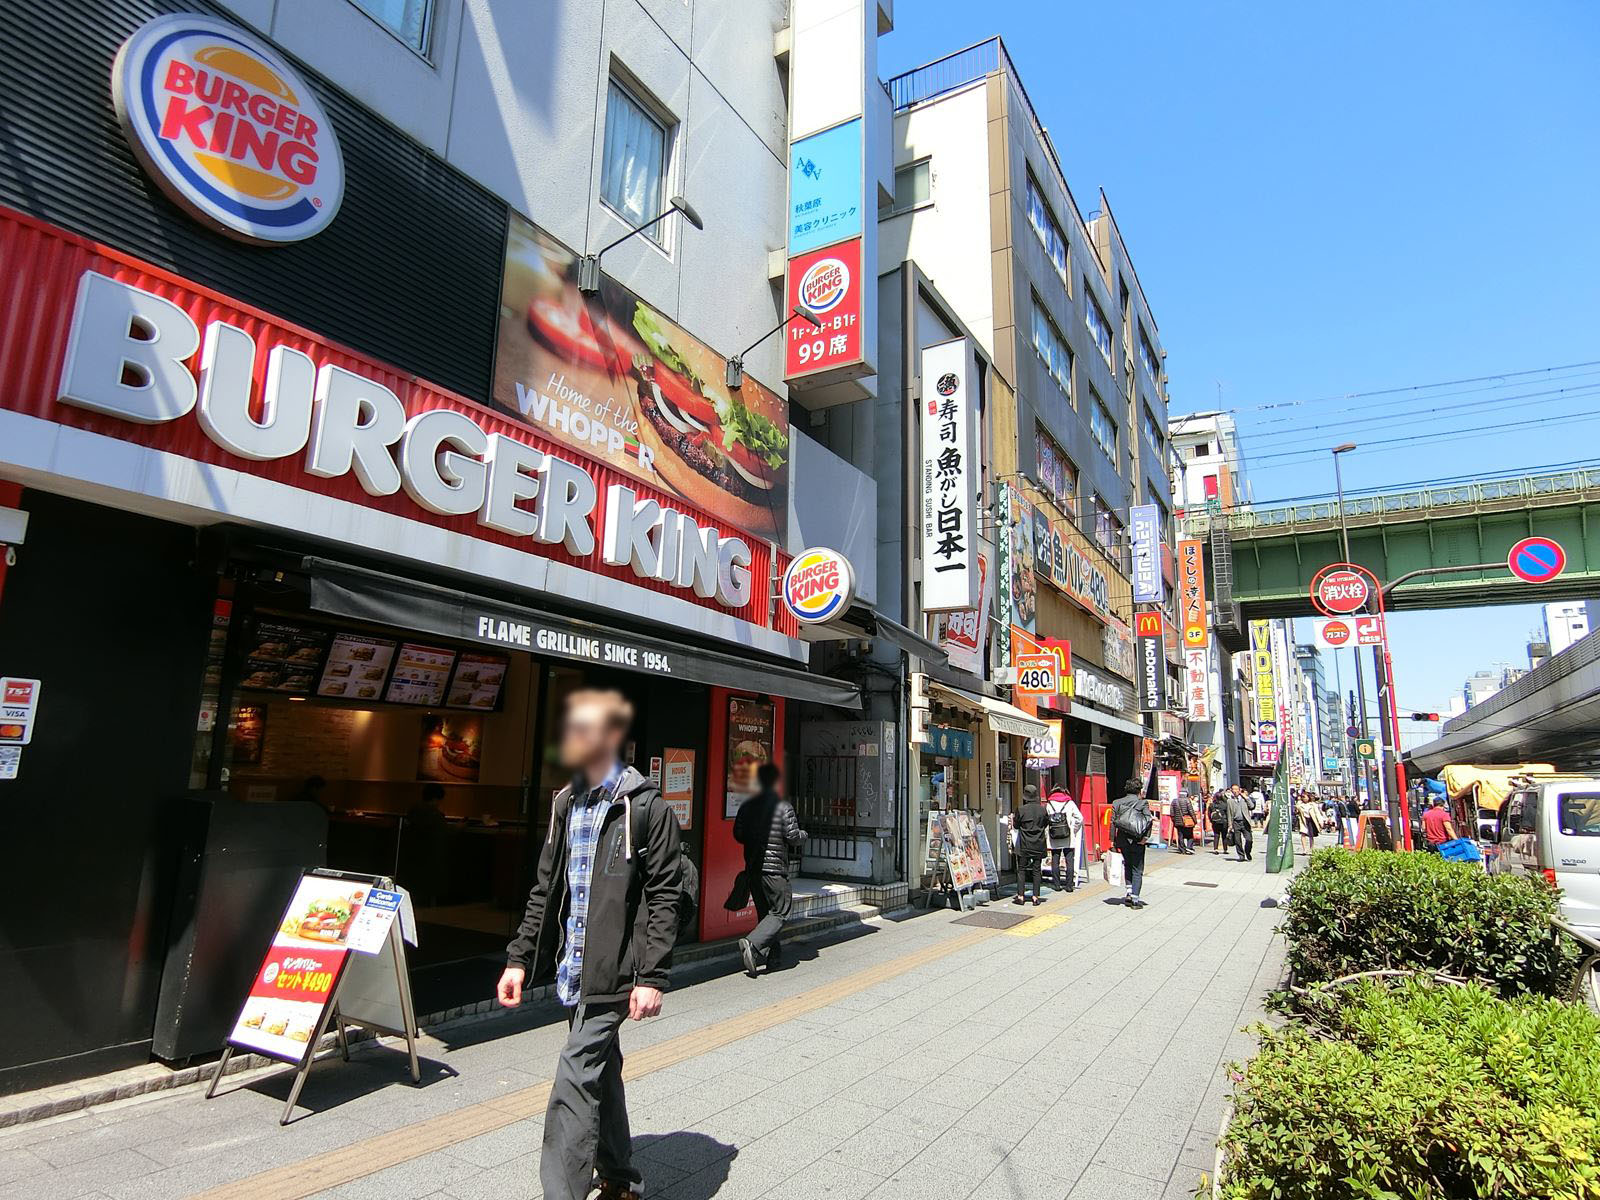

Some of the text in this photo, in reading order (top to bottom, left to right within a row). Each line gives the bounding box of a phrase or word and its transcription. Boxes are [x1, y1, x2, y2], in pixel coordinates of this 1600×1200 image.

[164, 60, 319, 147] BURGER
[160, 97, 319, 186] KING
[795, 197, 822, 213] 秋葉原
[794, 207, 856, 234] 美容クリニック
[807, 267, 840, 293] BURGER
[807, 274, 842, 304] KING
[546, 373, 639, 436] Home of the
[57, 270, 752, 608] BURGER KING
[925, 459, 933, 538] STANDING SUSHI BAR
[790, 561, 838, 588] BURGER
[792, 572, 839, 605] KING
[1324, 583, 1364, 600] 消火栓
[478, 616, 671, 673] FLAME GRILLING SINCE 1954.
[1327, 631, 1347, 639] ガスト
[1145, 639, 1158, 708] McDonald's
[1189, 652, 1206, 718] 不動産屋
[6, 710, 26, 718] VISA
[1032, 758, 1045, 768] 2F
[276, 970, 302, 990] セット
